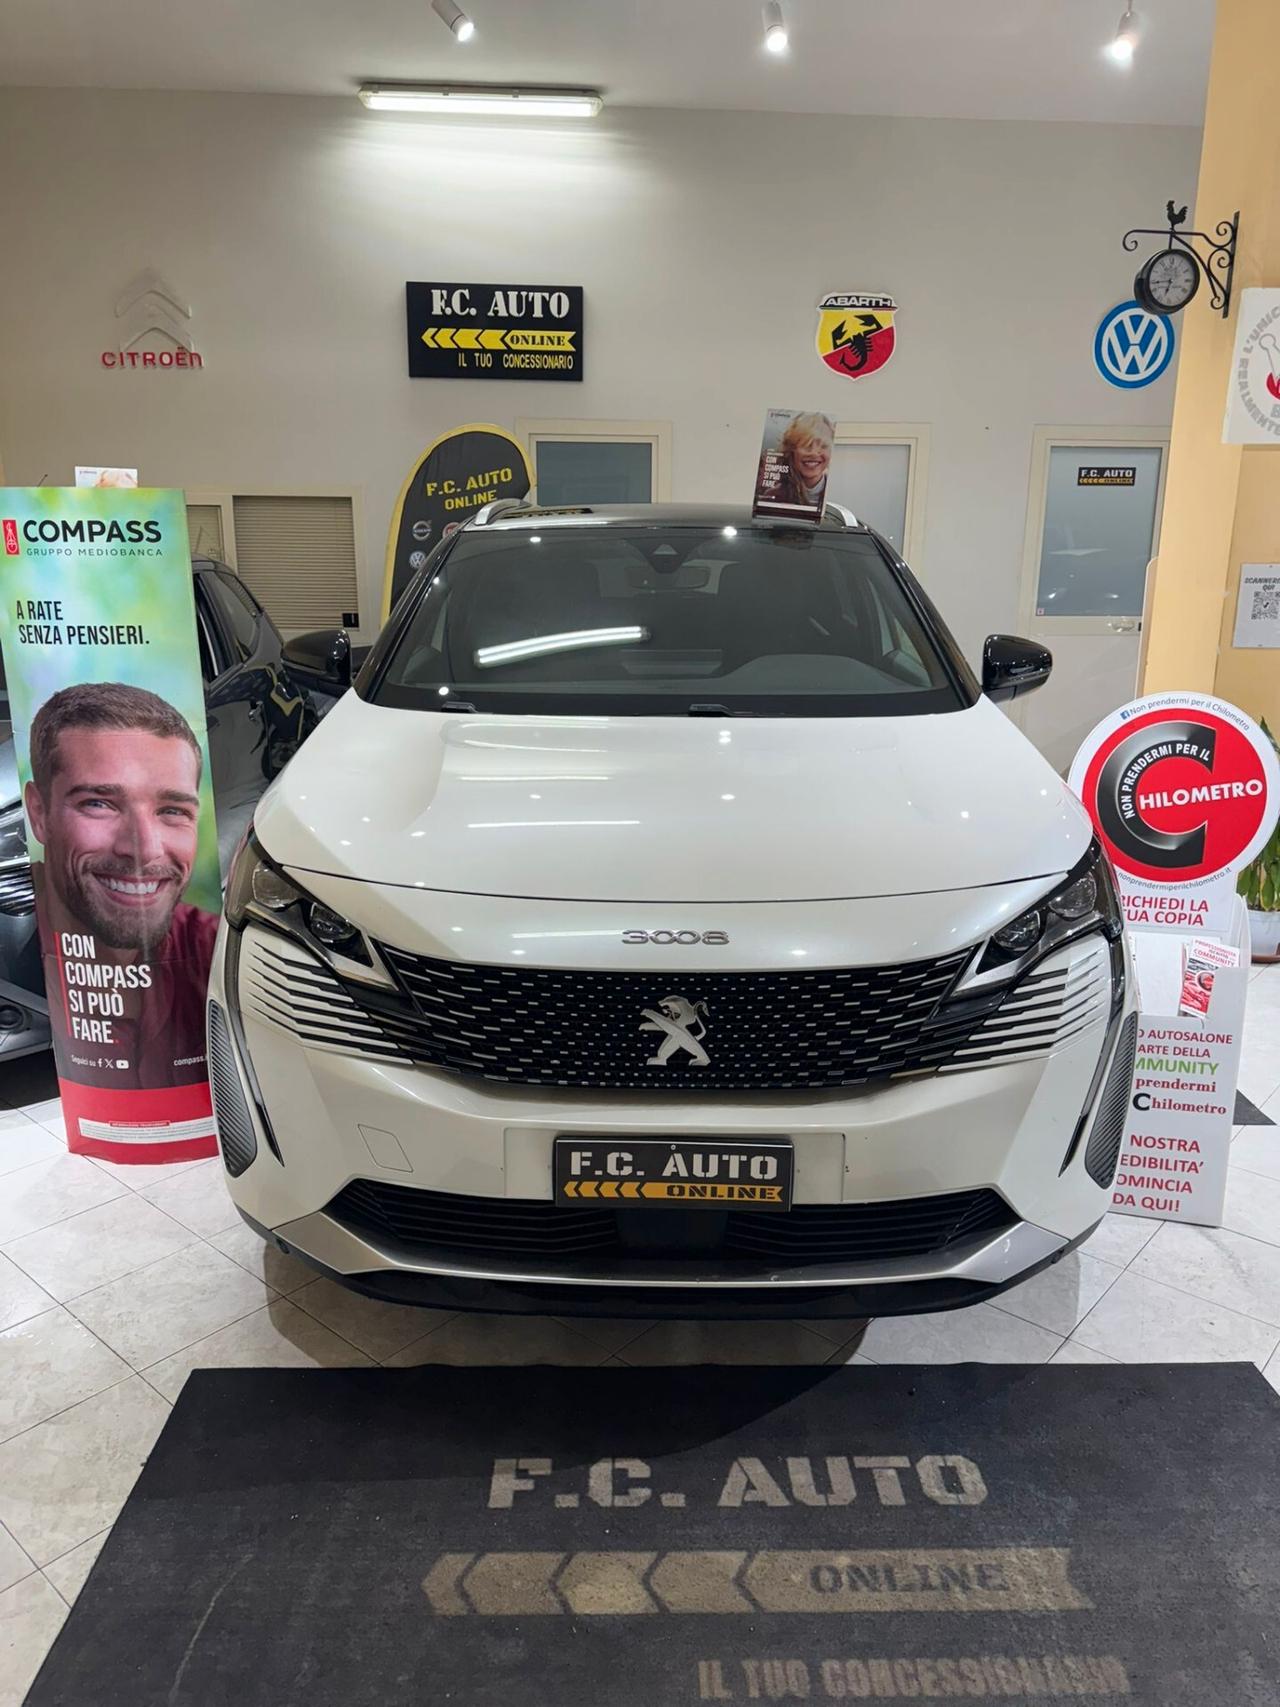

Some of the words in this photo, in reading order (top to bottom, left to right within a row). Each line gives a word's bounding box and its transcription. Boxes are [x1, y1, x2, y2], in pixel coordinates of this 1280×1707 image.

[431, 288, 477, 316] F.C.
[488, 291, 570, 318] AUTO
[826, 297, 892, 306] ABARTH
[510, 335, 565, 346] ONLINE
[458, 353, 467, 367] IL
[474, 353, 492, 367] TUO
[503, 354, 573, 370] CONCESSIONARIO
[426, 480, 462, 497] F.C.
[466, 467, 513, 491] AUTO
[1081, 469, 1100, 477] F.C.
[1104, 469, 1133, 478] AUTO
[444, 490, 497, 511] ONLINE
[23, 519, 162, 543] COMPASS
[27, 548, 72, 557] GRUPPO
[78, 548, 163, 557] MEDIOBANCA
[16, 601, 25, 620] A
[28, 601, 63, 620] RATE
[19, 625, 62, 645] SENZA
[68, 625, 150, 645] PENSIERI.
[1130, 704, 1147, 715] Non
[1148, 697, 1190, 710] prendermi
[1191, 699, 1205, 707] per
[1212, 703, 1250, 731] Chilometro
[1176, 743, 1198, 756] PER
[1199, 748, 1211, 761] IL
[1122, 743, 1173, 793] PRENDERMI
[1121, 795, 1136, 819] NON
[1190, 899, 1209, 912] LA
[1123, 909, 1149, 922] UA
[1154, 911, 1204, 926] COPIA
[61, 933, 96, 959] CON
[622, 930, 730, 945] 3008
[1194, 948, 1235, 966] COMMUNITY
[65, 961, 152, 990] COMPASS
[69, 989, 84, 1015] SI
[88, 988, 124, 1017] PUÒ
[1148, 1029, 1233, 1044] AUTOSALONE
[1173, 1046, 1210, 1058] DELLA
[1135, 1078, 1216, 1092] prendermi
[1132, 1093, 1227, 1115] Chilometro
[1130, 1134, 1201, 1153] NOSTRA
[570, 1151, 645, 1176] F.C.
[662, 1152, 778, 1179] AUTO
[666, 1185, 778, 1200] ONLINE
[1112, 1193, 1136, 1206] DA
[1141, 1196, 1180, 1212] QUI!
[487, 1457, 688, 1509] F.C.
[717, 1454, 990, 1508] AUTO
[810, 1563, 1009, 1594] ONLINE
[698, 1660, 732, 1698] IL
[742, 1660, 810, 1698] TUO
